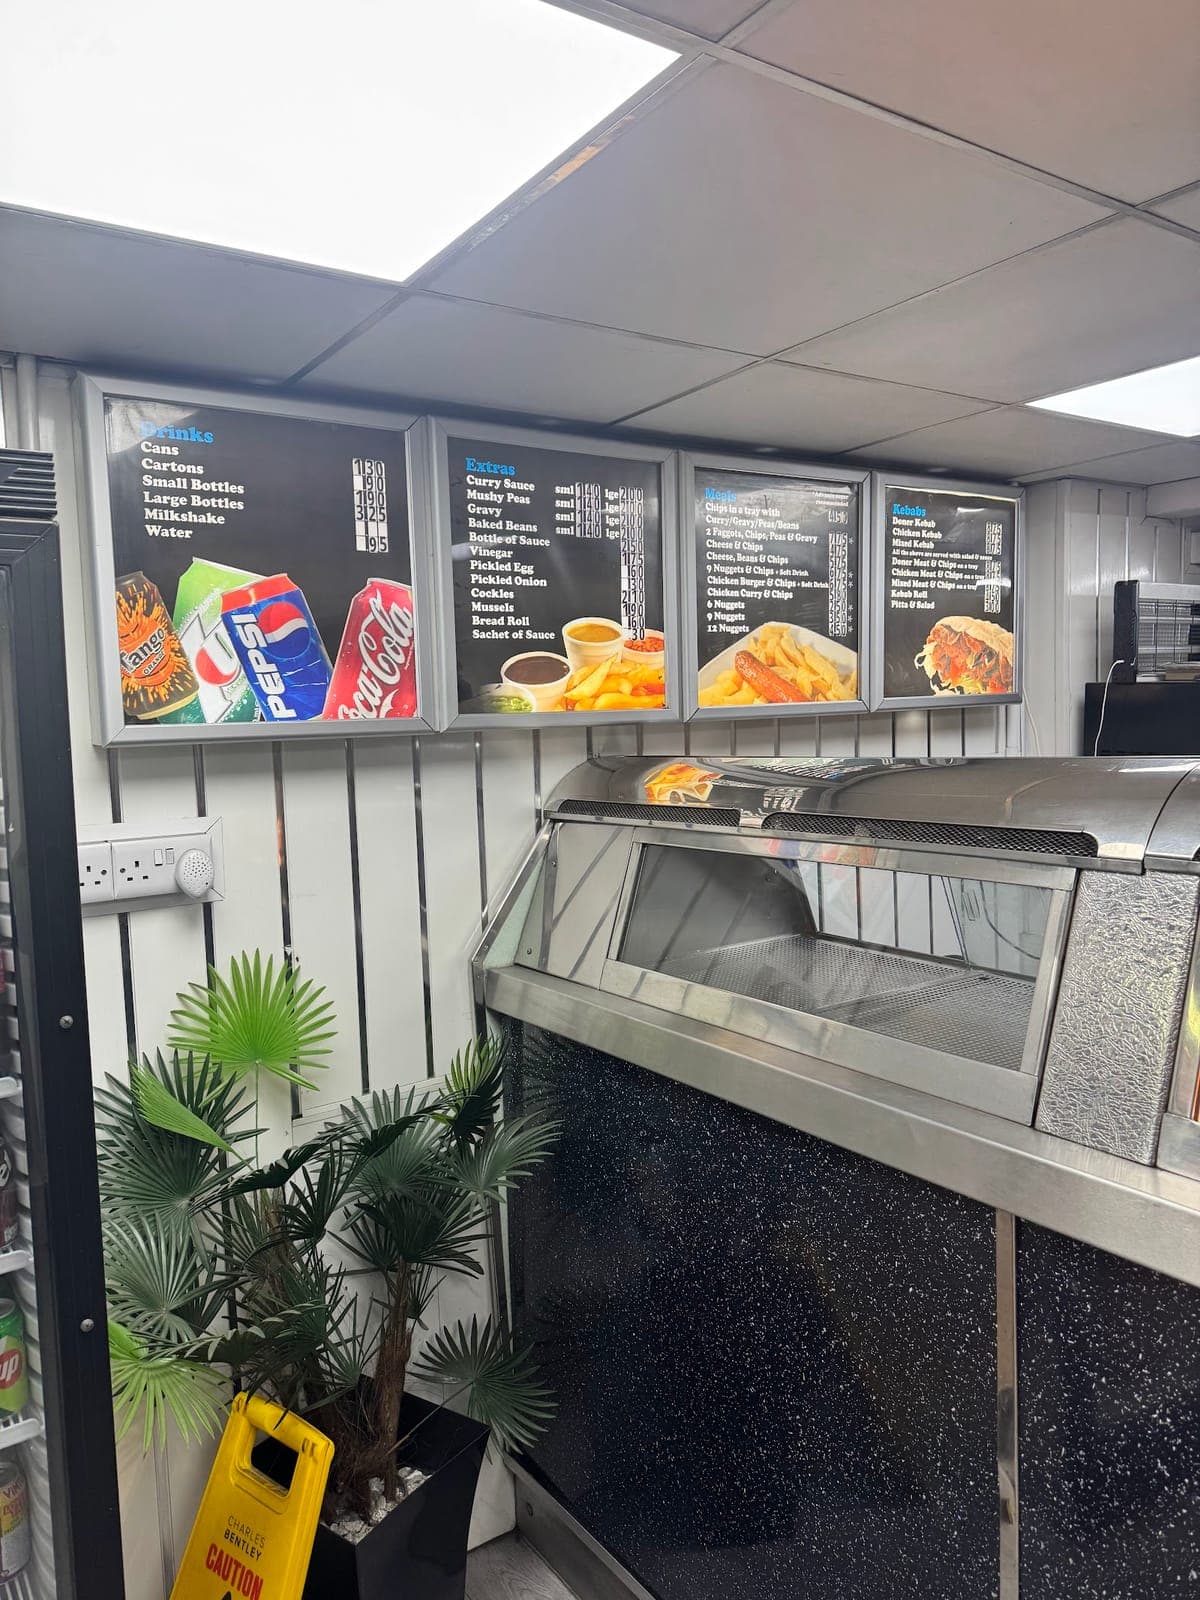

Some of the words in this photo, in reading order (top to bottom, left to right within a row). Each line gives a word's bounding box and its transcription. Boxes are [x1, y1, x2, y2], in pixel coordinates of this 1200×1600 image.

[140, 421, 214, 443] Drinks
[140, 441, 179, 455] Cans
[142, 458, 204, 474] Cartons
[466, 457, 516, 476] Extras
[142, 475, 187, 490] Small
[191, 478, 244, 494] Bottles
[466, 475, 501, 489] Curry
[504, 479, 535, 491] Sauce
[466, 489, 504, 504] Mushy
[507, 493, 530, 504] Peas
[555, 485, 574, 495] sml
[605, 489, 619, 500] lge
[143, 492, 188, 507] Large
[191, 495, 244, 510] Bottles
[555, 499, 574, 508] sml
[605, 502, 619, 513] lge
[467, 504, 502, 517] Gravy
[706, 502, 727, 514] Chips
[745, 507, 760, 516] tray
[762, 508, 780, 516] with
[893, 504, 926, 517] Kebabs
[144, 508, 225, 524] Milkshake
[555, 512, 574, 522] sml
[605, 515, 620, 526] lge
[892, 516, 914, 526] Doner
[915, 518, 936, 528] Kebab
[145, 525, 193, 538] Water
[468, 518, 503, 529] Baked
[506, 520, 538, 532] Beans
[469, 532, 503, 543] Bottle
[505, 535, 518, 544] of
[519, 536, 551, 546] Sauce
[606, 528, 620, 540] lge
[706, 528, 711, 536] 2
[770, 531, 786, 540] Peas
[795, 533, 817, 544] Gravy
[892, 528, 920, 537] Chicken
[922, 530, 942, 539] Kebab
[706, 539, 733, 549] Cheese
[742, 542, 763, 552] Chips
[913, 540, 934, 549] Kebab
[470, 546, 513, 559] Vinegar
[706, 551, 735, 562] Cheese,
[737, 553, 758, 562] Beans
[767, 555, 788, 566] Chips
[470, 560, 512, 571] Pickled
[514, 563, 534, 574] Egg
[892, 557, 912, 566] Doner
[913, 558, 930, 566] Meat
[938, 560, 957, 569] Chips
[706, 565, 712, 573] 9
[713, 564, 744, 574] Nuggets
[753, 566, 774, 576] Chips
[892, 568, 919, 577] Chicken
[920, 570, 936, 578] Meat
[945, 571, 963, 580] Chips
[471, 574, 512, 585] Pickled
[514, 576, 547, 586] Onion
[707, 576, 739, 584] Chicken
[740, 577, 765, 588] Burger
[775, 579, 796, 589] Chips
[912, 580, 928, 588] Meat
[937, 581, 955, 591] Chips
[471, 588, 514, 599] Cockles
[707, 587, 739, 597] Chicken
[740, 589, 762, 599] Curry
[772, 590, 793, 600] Chips
[891, 590, 912, 598] Kebab
[913, 590, 928, 598] Roll
[472, 602, 514, 612] Mussels
[707, 600, 713, 608] 6
[714, 600, 745, 610] Nuggets
[891, 600, 908, 608] Pitta
[917, 601, 935, 609] Salad
[472, 616, 505, 626] Bread
[507, 616, 530, 626] Roll
[707, 613, 713, 621] 9
[714, 612, 745, 622] Nuggets
[472, 630, 509, 639] Sachet
[512, 630, 524, 639] of
[526, 630, 555, 639] Sauce
[719, 624, 749, 634] Nuggets
[120, 627, 166, 674] Tango
[231, 614, 297, 718] PEPSI
[228, 1515, 265, 1548] CHARLES
[224, 1528, 262, 1560] BENTLEY
[206, 1542, 263, 1600] CAUTION
